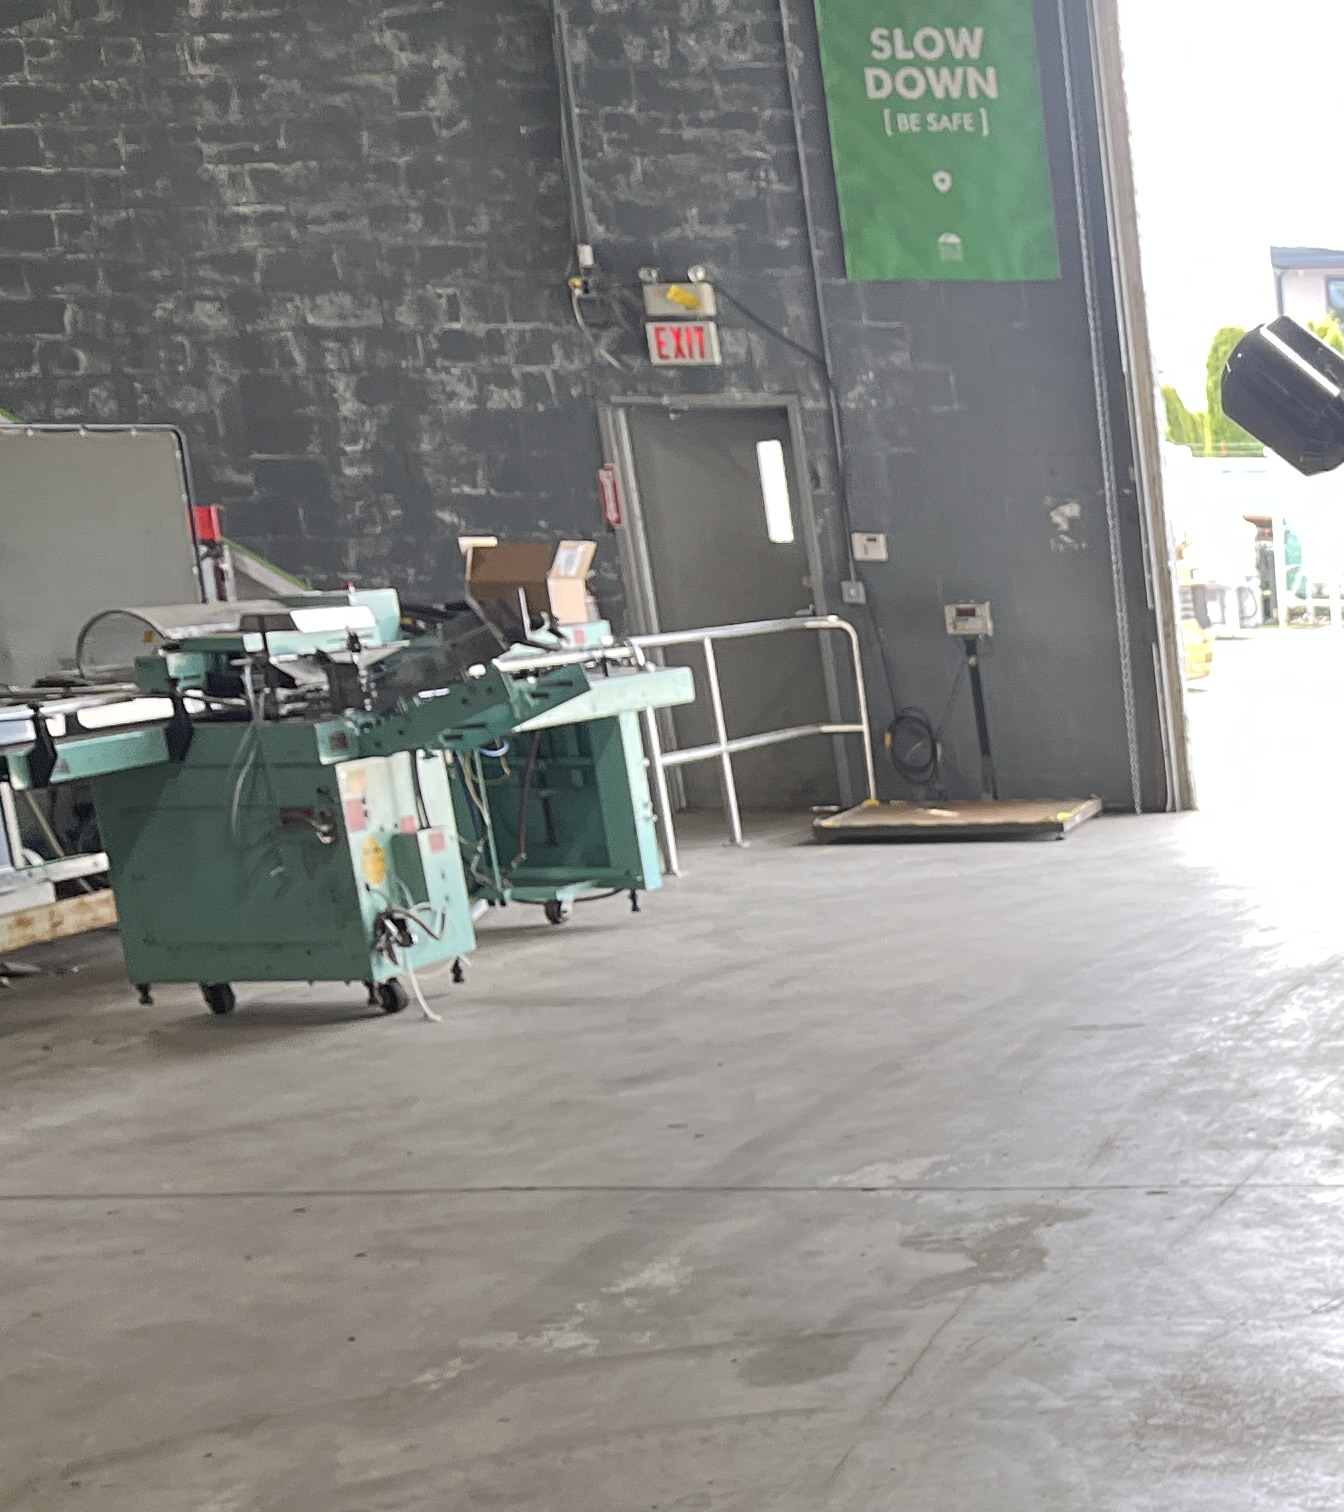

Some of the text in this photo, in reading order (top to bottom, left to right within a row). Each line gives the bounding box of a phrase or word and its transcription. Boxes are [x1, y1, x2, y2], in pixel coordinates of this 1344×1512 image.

[870, 26, 984, 60] SLOW
[864, 66, 999, 100] DOWN
[654, 325, 705, 360] EXIT
